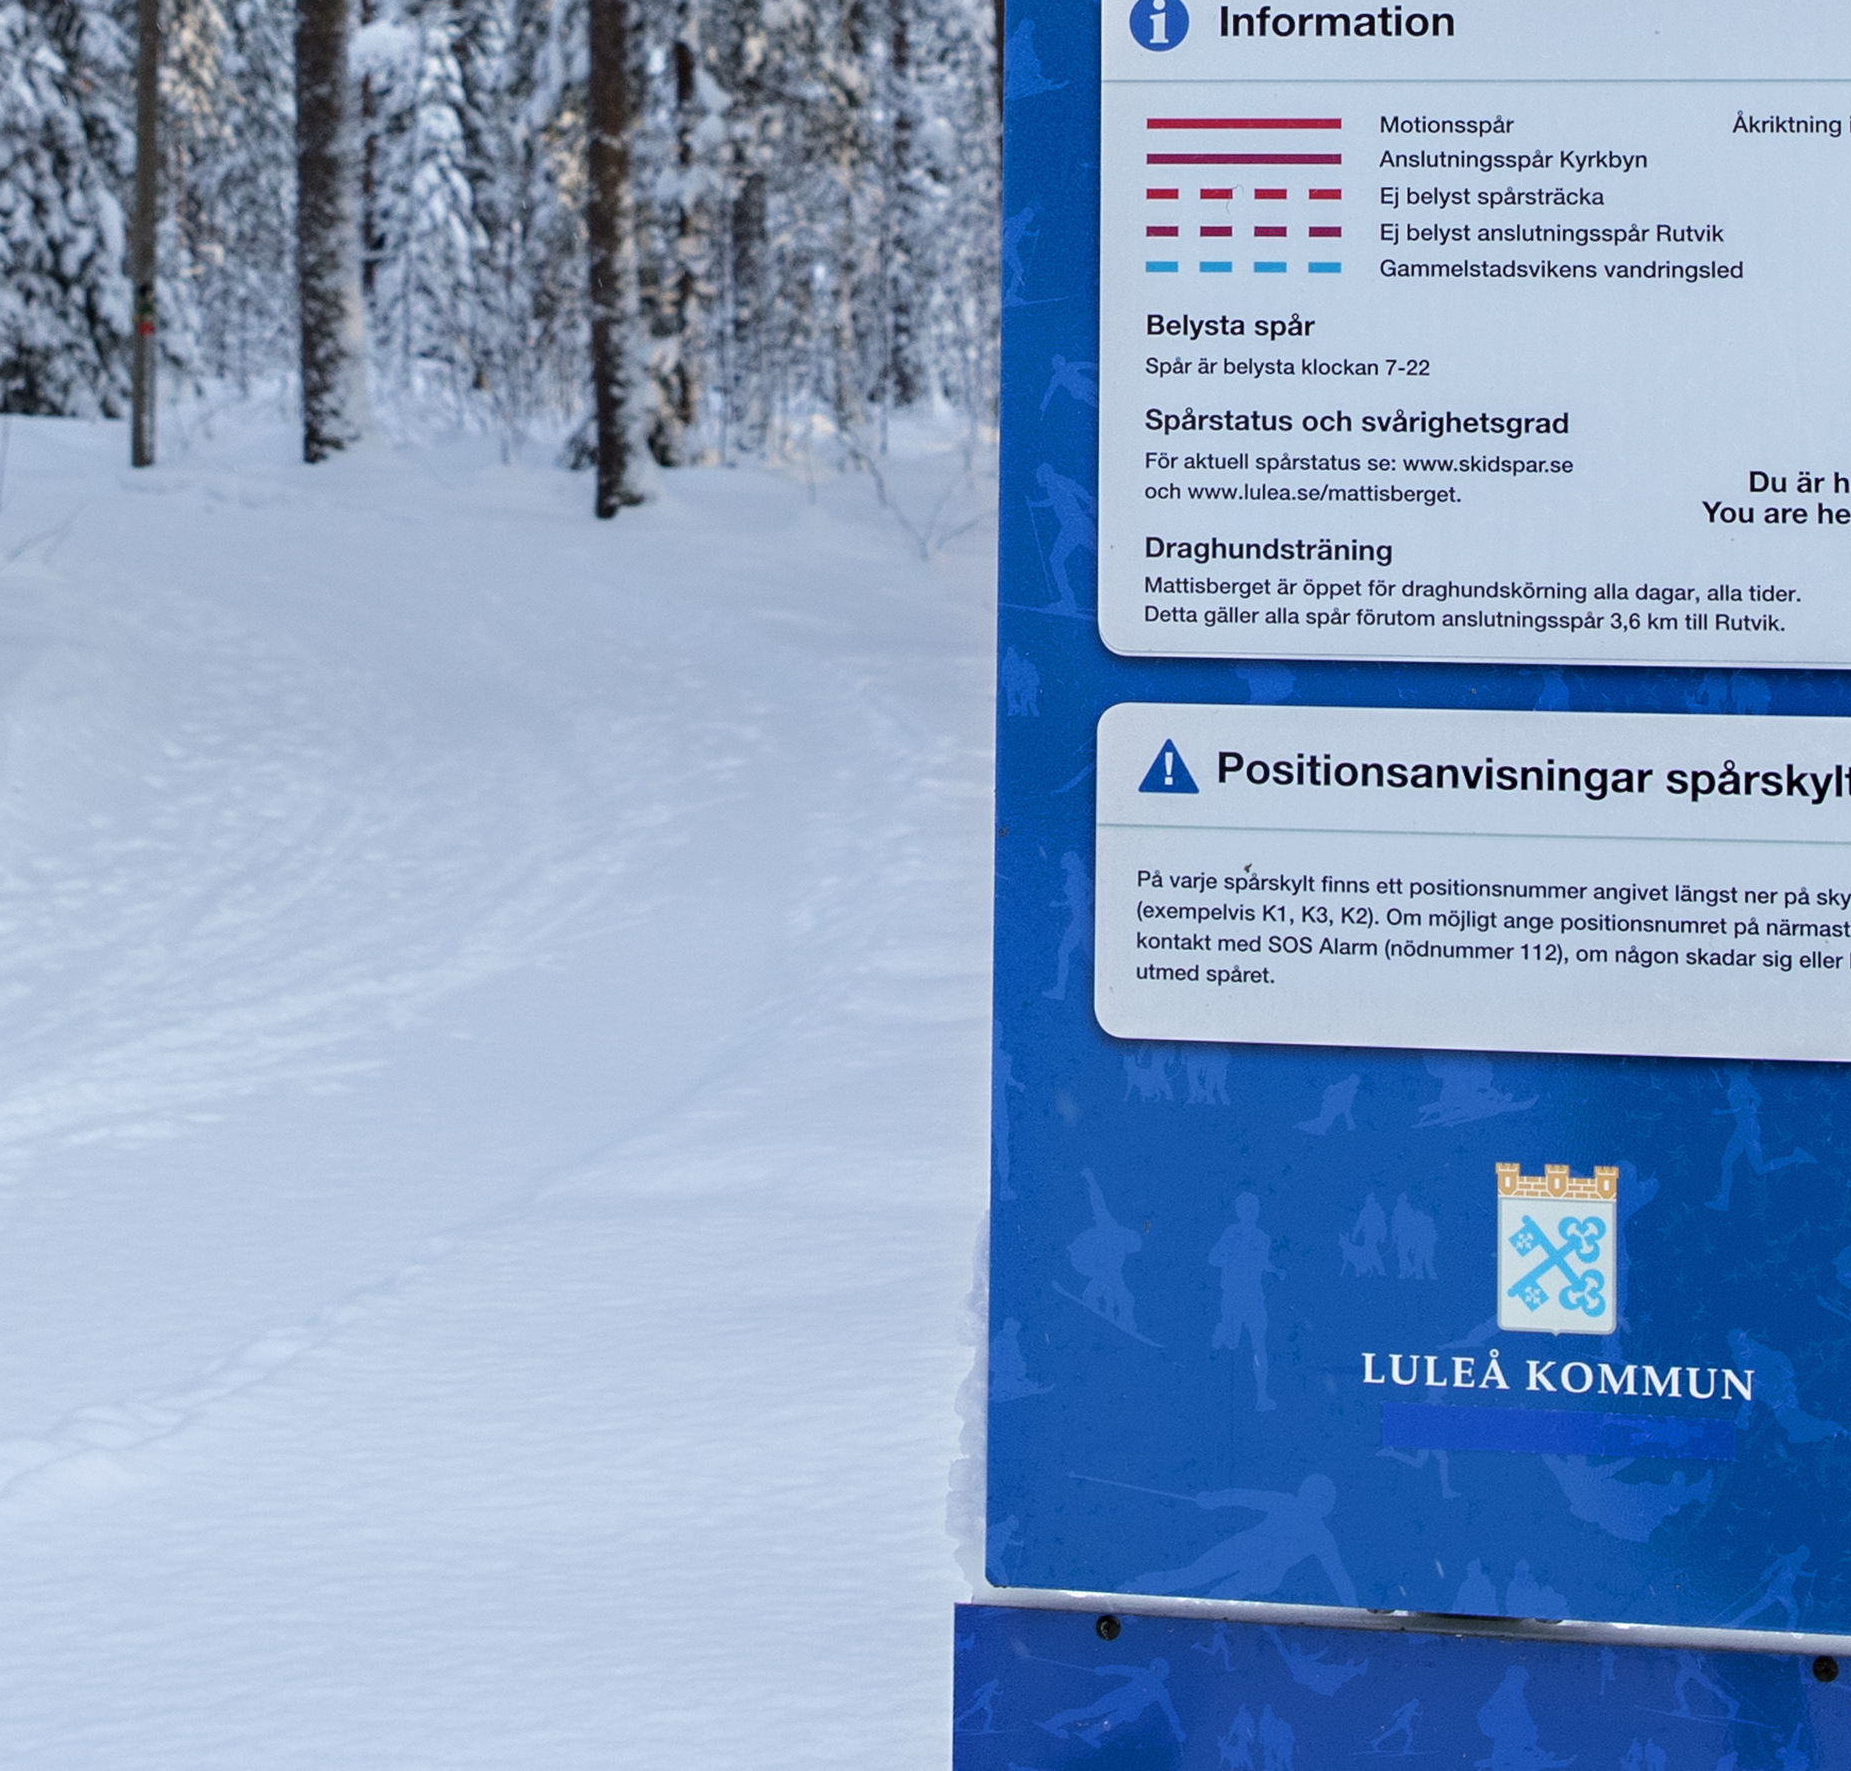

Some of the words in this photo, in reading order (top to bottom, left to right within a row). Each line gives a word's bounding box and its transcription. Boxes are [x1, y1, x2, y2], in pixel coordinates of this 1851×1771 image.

[1220, 4, 1455, 37] Information
[1380, 114, 1515, 138] Motionsspår
[1732, 109, 1842, 138] Åkriktning
[1379, 149, 1554, 173] Anslutningsspår
[1560, 150, 1648, 173] Kyrkbyn
[1380, 186, 1399, 210] Ej
[1406, 186, 1471, 210] belyst
[1477, 186, 1605, 210] spårsträcka
[1380, 223, 1399, 246] Ej
[1406, 223, 1471, 246] belyst
[1477, 223, 1651, 247] anslutningsspår
[1656, 224, 1725, 243] Rutvik
[1380, 258, 1598, 279] Gammelstadsvikens
[1603, 260, 1744, 284] vandringsled
[1147, 313, 1245, 341] Belysta
[1254, 312, 1316, 342] spår
[1145, 356, 1193, 379] Spår
[1197, 357, 1218, 375] är
[1223, 357, 1296, 379] belysta
[1301, 358, 1379, 376] klockan
[1385, 359, 1430, 377] 7-22
[1145, 406, 1293, 436] Spårstatus
[1302, 409, 1352, 432] och
[1361, 408, 1569, 440] svårighetsgrad
[1145, 451, 1179, 470] För
[1183, 452, 1249, 470] aktuell
[1255, 452, 1361, 474] spårstatus
[1367, 458, 1396, 472] se:
[1402, 455, 1574, 477] www.skidspar.se
[1144, 482, 1181, 500] och
[1187, 483, 1462, 507] www.lulea.se/mattisberget.
[1749, 470, 1787, 493] Du
[1796, 470, 1826, 494] är
[1701, 500, 1755, 524] You
[1764, 507, 1809, 525] are
[1145, 536, 1393, 567] Draghundsträning
[1144, 576, 1271, 599] Mattisberget
[1277, 578, 1298, 596] är
[1302, 578, 1362, 600] öppet
[1367, 579, 1397, 597] för
[1401, 580, 1587, 604] draghundskörning
[1593, 582, 1630, 601] alla
[1635, 583, 1700, 606] dagar,
[1707, 584, 1743, 602] alla
[1748, 584, 1802, 603] tider.
[1144, 605, 1198, 623] Detta
[1203, 606, 1260, 628] gäller
[1264, 607, 1300, 625] alla
[1305, 607, 1351, 629] spår
[1356, 608, 1435, 627] förutom
[1441, 610, 1605, 633] anslutningsspår
[1610, 612, 1641, 633] 3,6
[1647, 612, 1678, 630] km
[1684, 613, 1708, 631] till
[1715, 613, 1786, 632] Rutvik.
[1218, 751, 1654, 801] Positionsanvisningar
[1137, 869, 1164, 888] På
[1169, 871, 1218, 894] varje
[1223, 872, 1316, 896] spårskylt
[1321, 875, 1370, 894] finns
[1376, 878, 1403, 895] ett
[1409, 878, 1588, 900] positionsnummer
[1593, 883, 1669, 905] angivet
[1675, 884, 1738, 908] längst
[1744, 890, 1779, 905] ner
[1784, 886, 1811, 909] på
[1136, 900, 1256, 924] (exempelvis
[1262, 904, 1295, 926] K1,
[1301, 905, 1334, 927] K3,
[1341, 906, 1380, 929] K2).
[1386, 907, 1422, 927] Om
[1428, 909, 1498, 933] möjligt
[1503, 915, 1554, 934] ange
[1560, 913, 1728, 935] positionsnumret
[1734, 916, 1760, 939] på
[1136, 931, 1212, 951] kontakt
[1217, 935, 1262, 953] med
[1268, 935, 1313, 955] SOS
[1318, 937, 1378, 956] Alarm
[1384, 938, 1515, 961] (nödnummer
[1520, 943, 1569, 966] 112),
[1575, 948, 1608, 963] om
[1615, 945, 1679, 969] någon
[1685, 947, 1757, 967] skadar
[1762, 949, 1793, 973] sig
[1799, 950, 1844, 970] eller
[1136, 963, 1200, 982] utmed
[1206, 964, 1275, 987] spåret.
[1361, 1348, 1511, 1390] LULEÅ
[1525, 1359, 1755, 1402] KOMMUN
